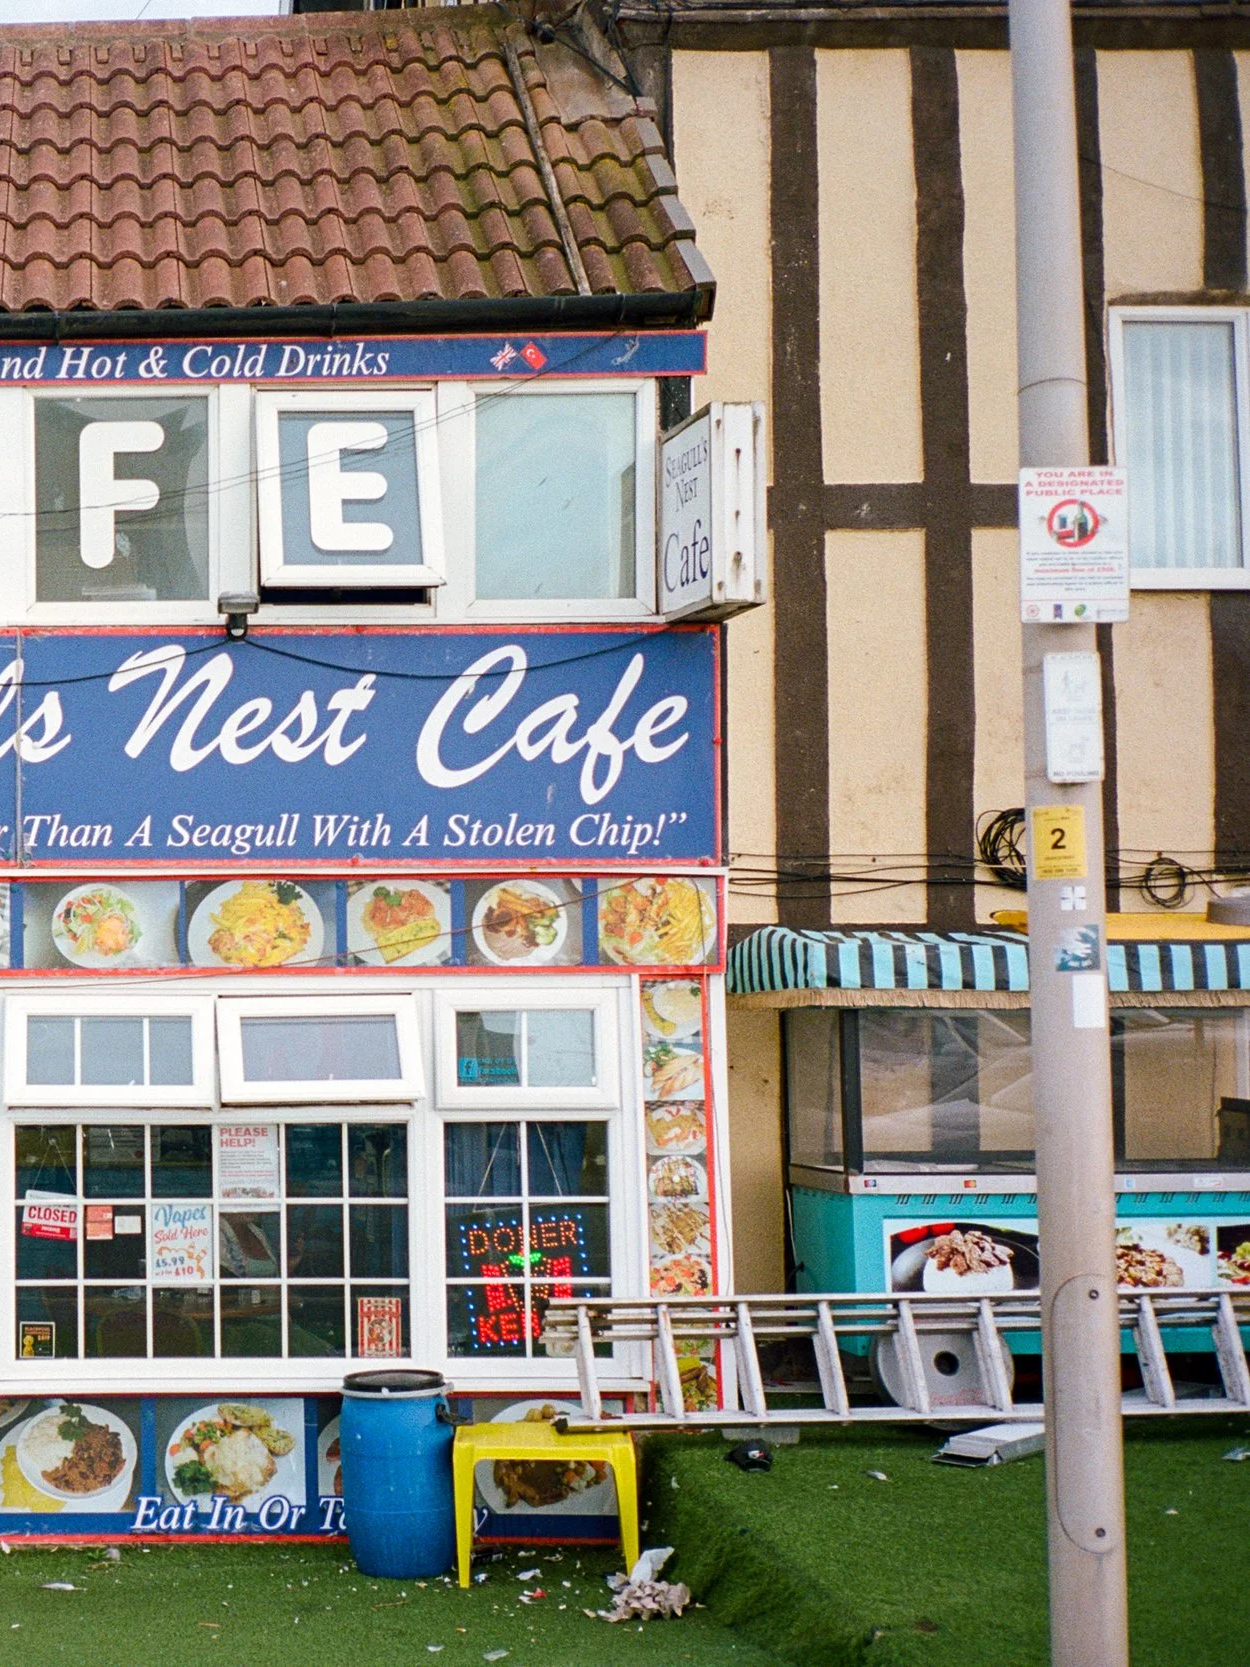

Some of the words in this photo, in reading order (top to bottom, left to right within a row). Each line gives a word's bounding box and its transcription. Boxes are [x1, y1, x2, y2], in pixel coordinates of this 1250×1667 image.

[56, 347, 128, 378] Hot
[138, 346, 168, 378] &
[182, 346, 268, 377] Cold
[276, 345, 390, 376] Drinks
[1080, 488, 1123, 496] PLACE
[664, 518, 710, 593] Cafe
[108, 644, 376, 772] Nest
[416, 644, 689, 805] Cafe
[23, 814, 112, 847] Than
[125, 814, 153, 847] A
[166, 813, 301, 854] Seagull
[313, 813, 391, 846] With
[402, 813, 430, 846] A
[443, 812, 555, 846] Stolen
[1051, 828, 1066, 850] 2
[220, 1127, 268, 1137] PLEASE
[220, 1138, 255, 1147] HELP!
[28, 1205, 77, 1223] CLOSED
[154, 1204, 207, 1228] Vapes
[154, 1227, 178, 1245] Sold
[180, 1225, 208, 1239] Here
[156, 1255, 185, 1267] £5.99
[174, 1265, 194, 1276] £10
[131, 1497, 192, 1530] Eat
[207, 1497, 248, 1530] In
[259, 1497, 306, 1530] Or
